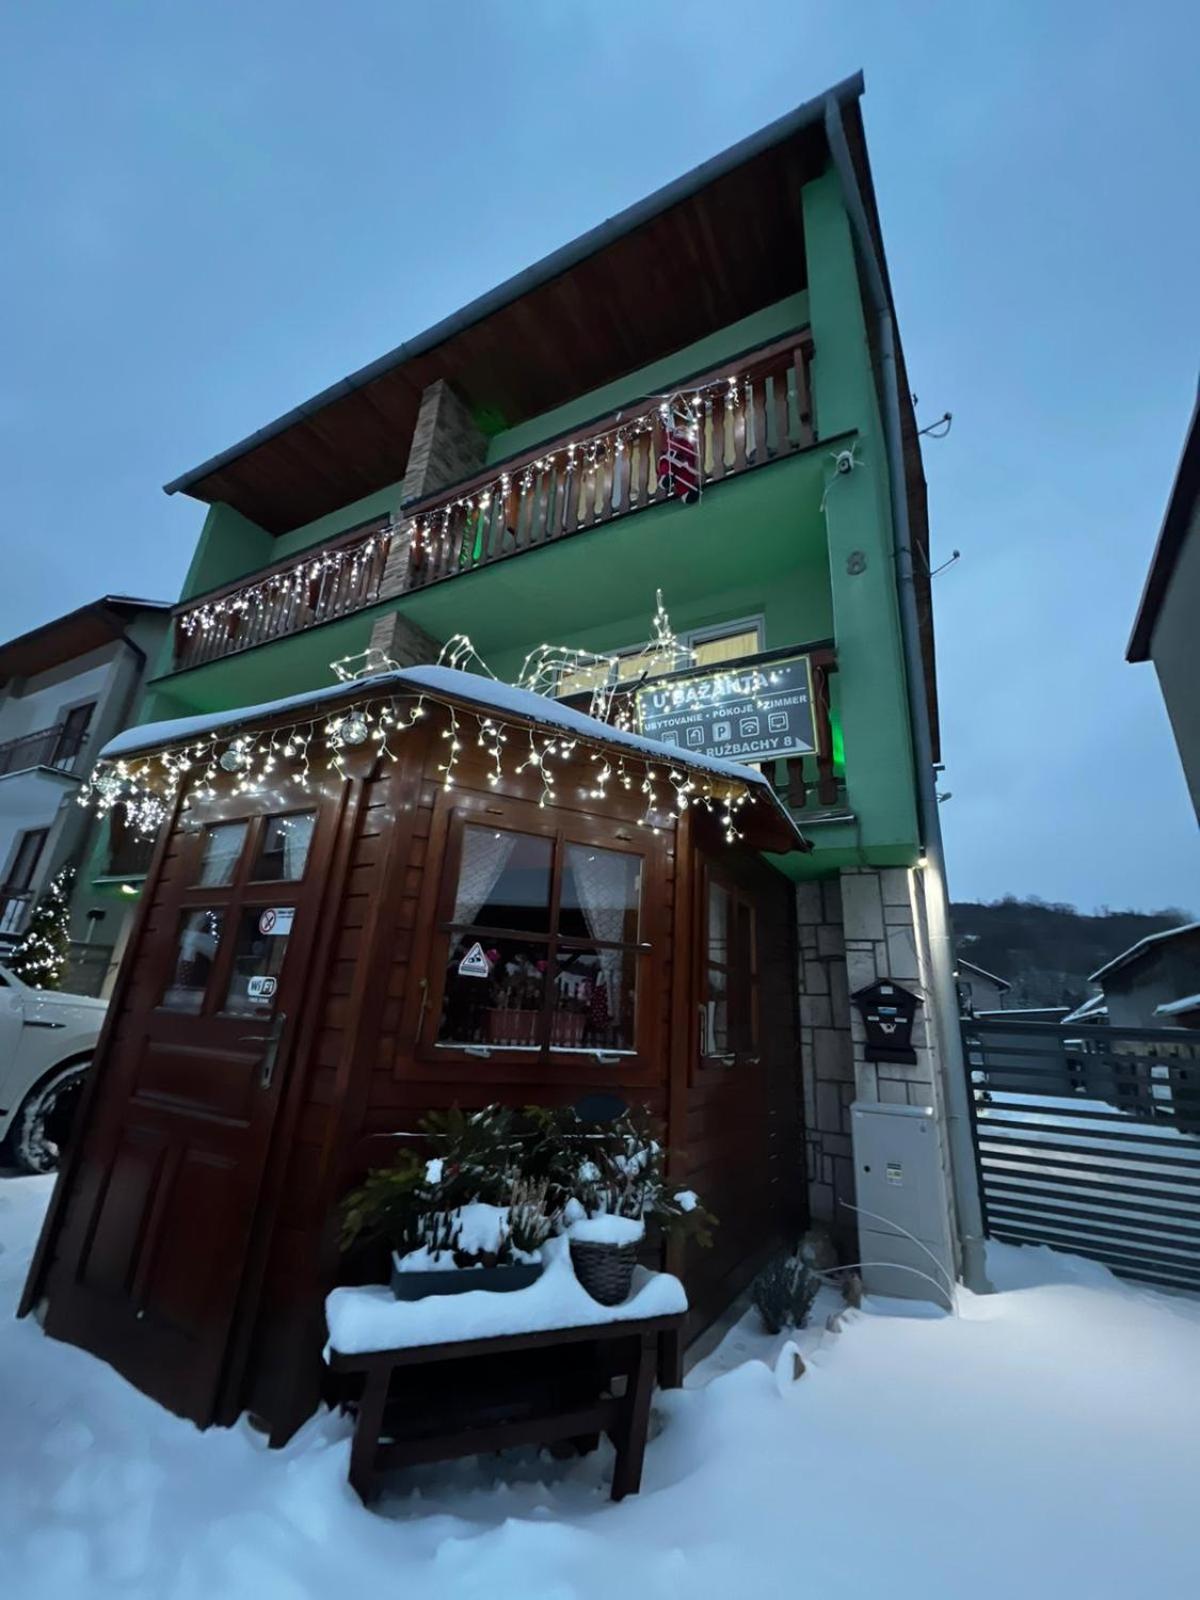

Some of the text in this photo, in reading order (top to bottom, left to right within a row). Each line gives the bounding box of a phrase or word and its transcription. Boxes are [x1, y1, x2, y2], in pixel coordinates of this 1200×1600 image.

[847, 550, 867, 576] 8
[653, 693, 666, 708] U
[644, 695, 807, 731] UBYTOVANIE POKOJE ZIMMER
[783, 736, 792, 746] 8
